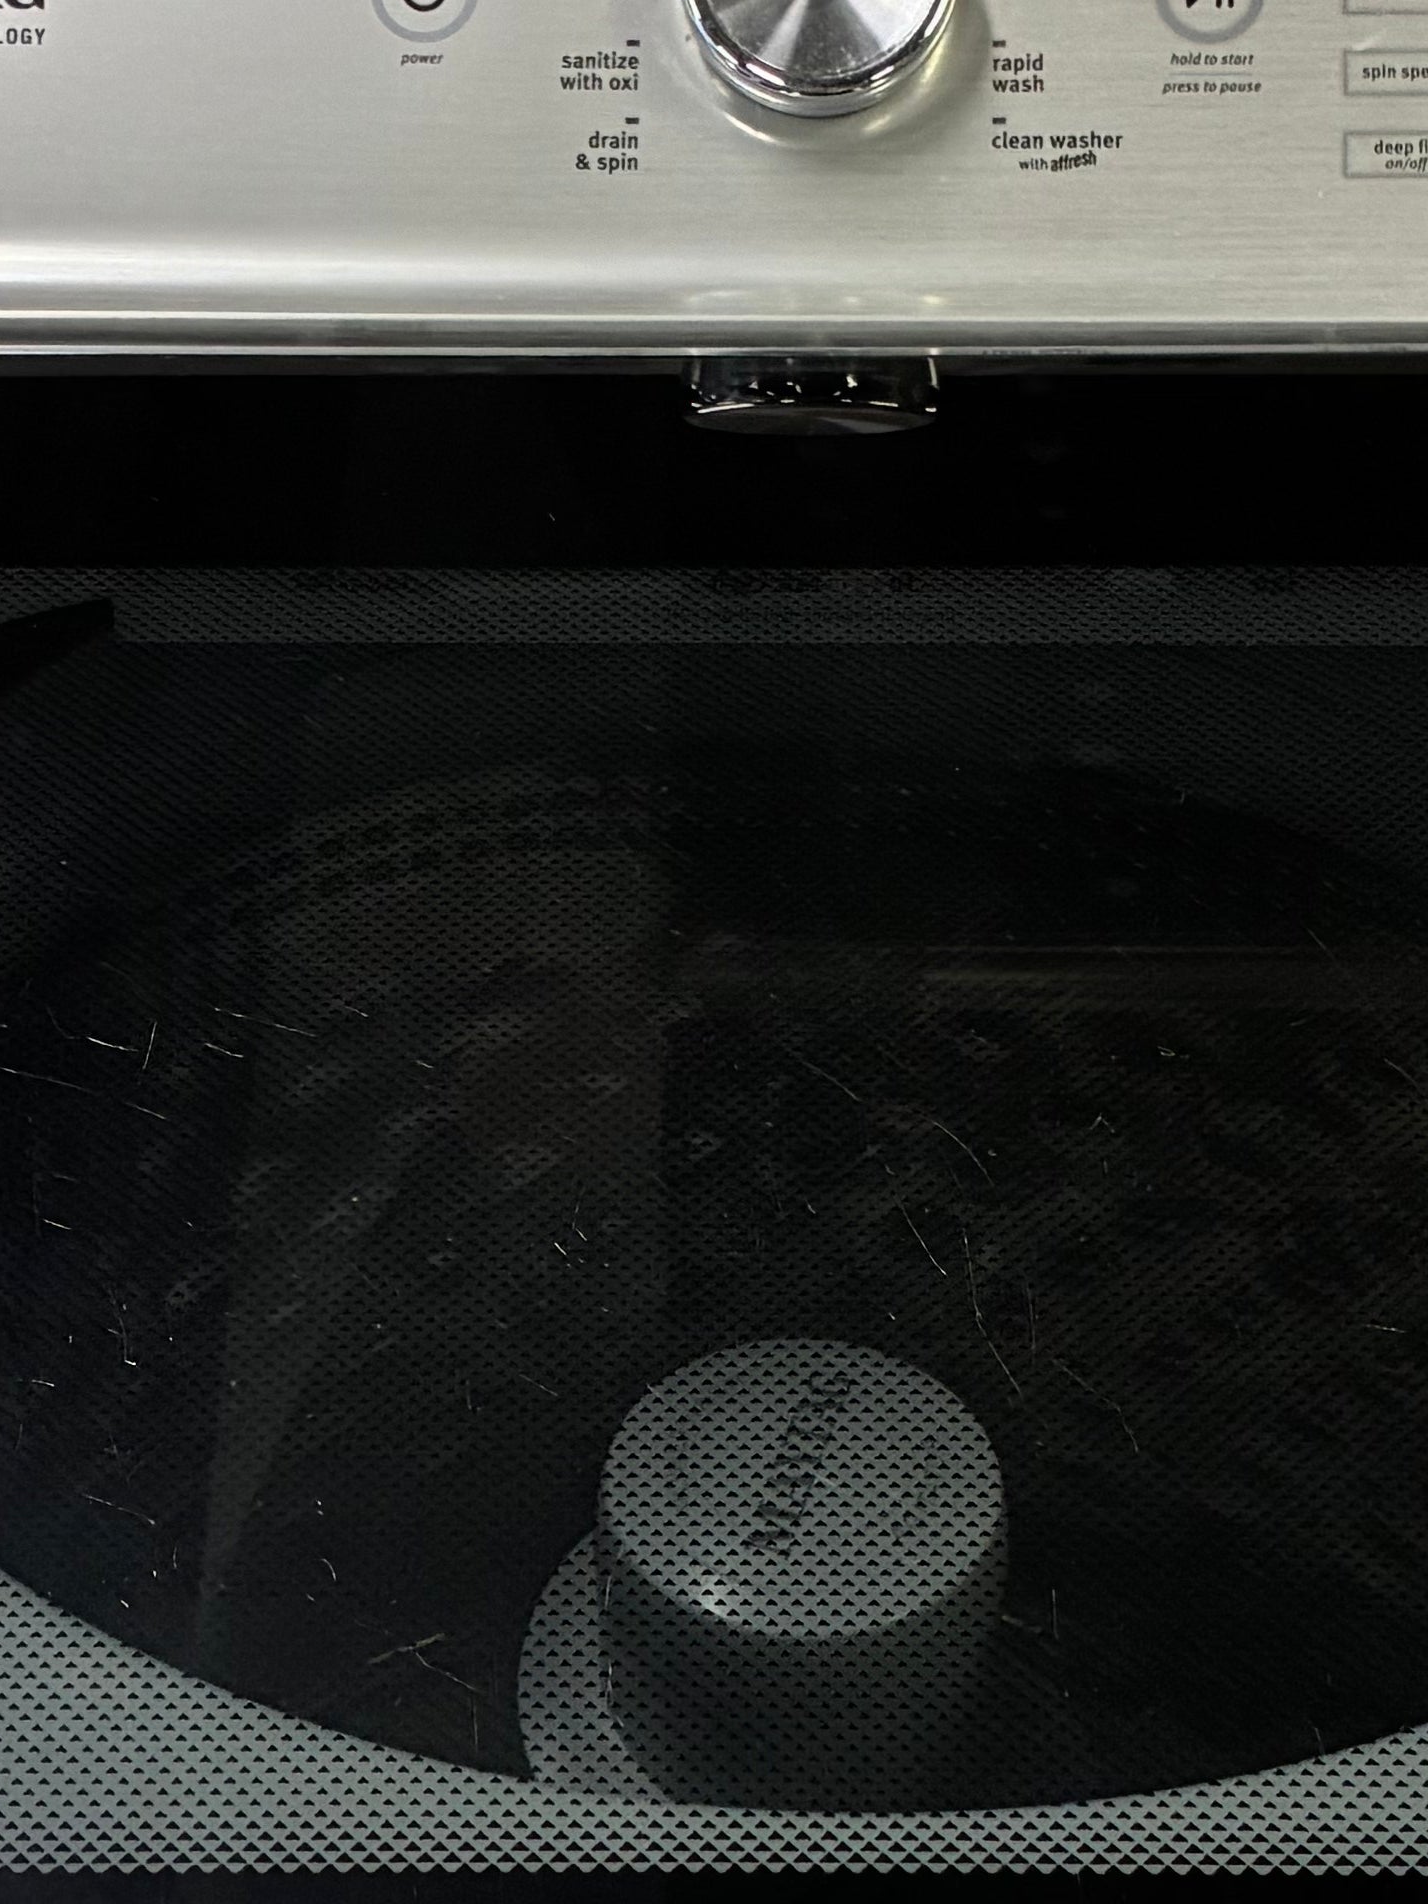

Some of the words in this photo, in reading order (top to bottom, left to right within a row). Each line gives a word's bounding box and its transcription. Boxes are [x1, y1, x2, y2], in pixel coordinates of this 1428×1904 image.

[400, 51, 444, 68] power
[560, 51, 639, 72] sanitize
[992, 52, 1044, 76] rapid
[1170, 51, 1201, 67] hold
[1203, 53, 1218, 67] to
[1221, 52, 1255, 67] start
[559, 72, 606, 92] with
[609, 73, 639, 92] oxi
[1362, 64, 1398, 81] spin
[991, 75, 1045, 95] wash
[1162, 81, 1199, 96] press
[1203, 80, 1218, 94] to
[1219, 81, 1262, 97] pause
[588, 131, 639, 151] drain
[991, 130, 1044, 150] clean
[1049, 130, 1124, 150] washer
[1373, 139, 1414, 156] deep
[574, 154, 593, 173] &
[596, 153, 639, 177] spin
[1018, 157, 1049, 171] with
[1050, 149, 1097, 172] affresh
[1384, 157, 1428, 173] on/off
